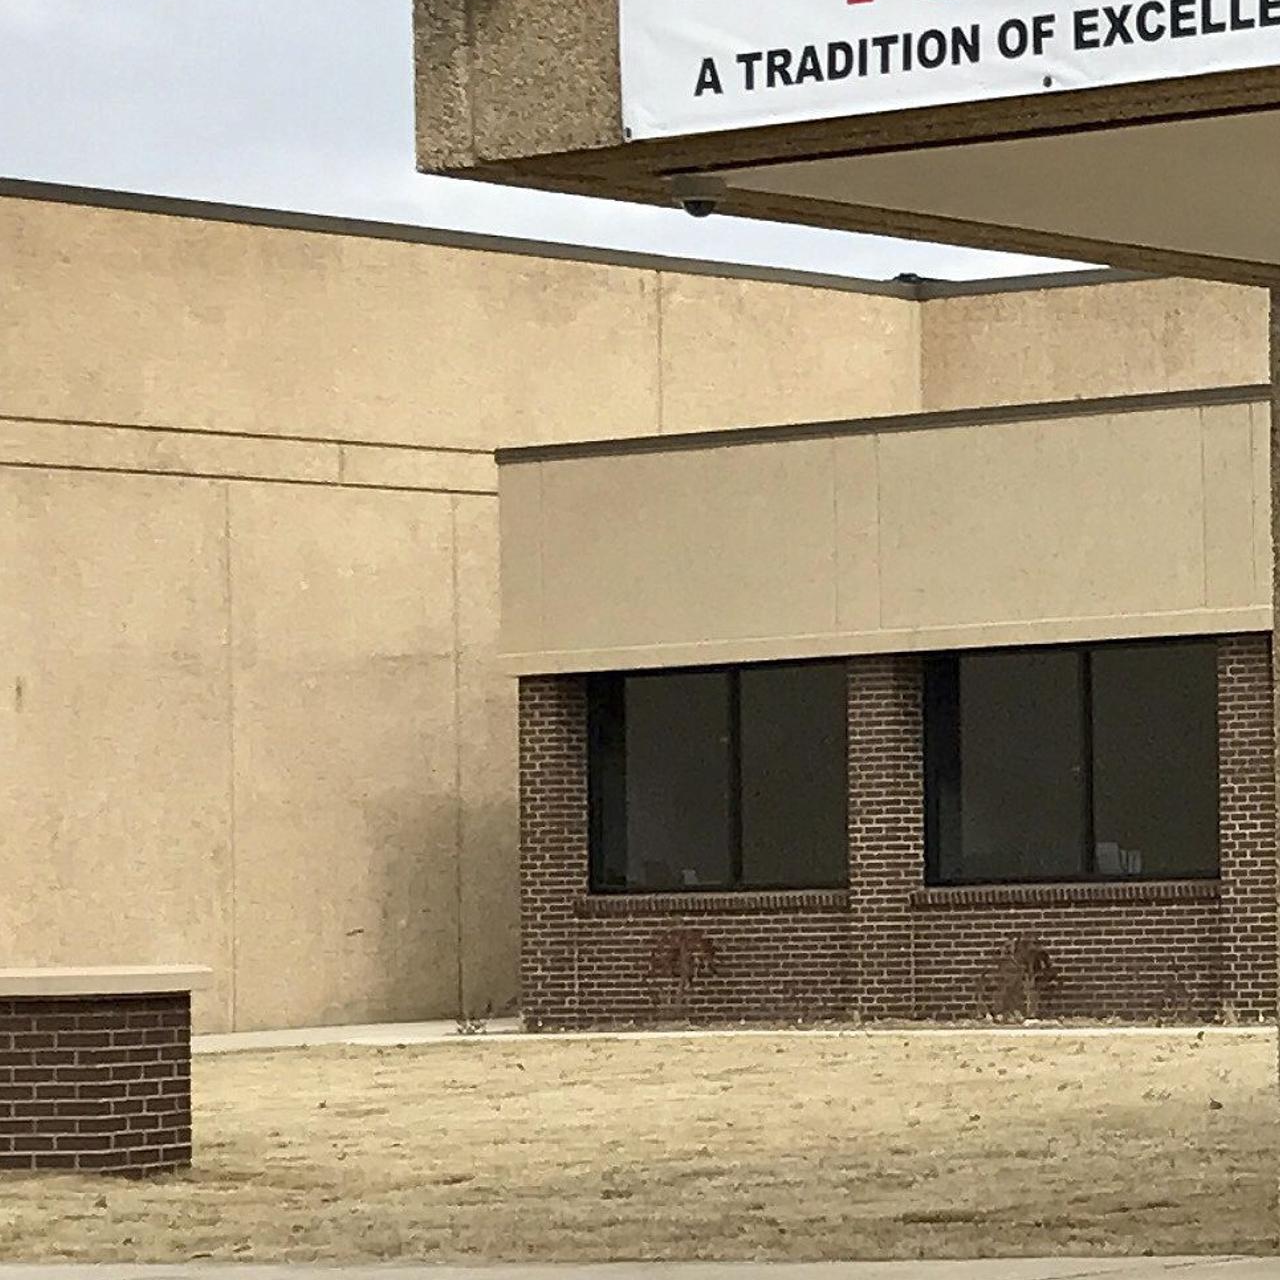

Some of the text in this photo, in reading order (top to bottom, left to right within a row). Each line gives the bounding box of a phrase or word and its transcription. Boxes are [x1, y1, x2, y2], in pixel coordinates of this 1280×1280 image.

[693, 57, 723, 97] A
[736, 24, 980, 91] TRADITION
[997, 14, 1056, 59] OF
